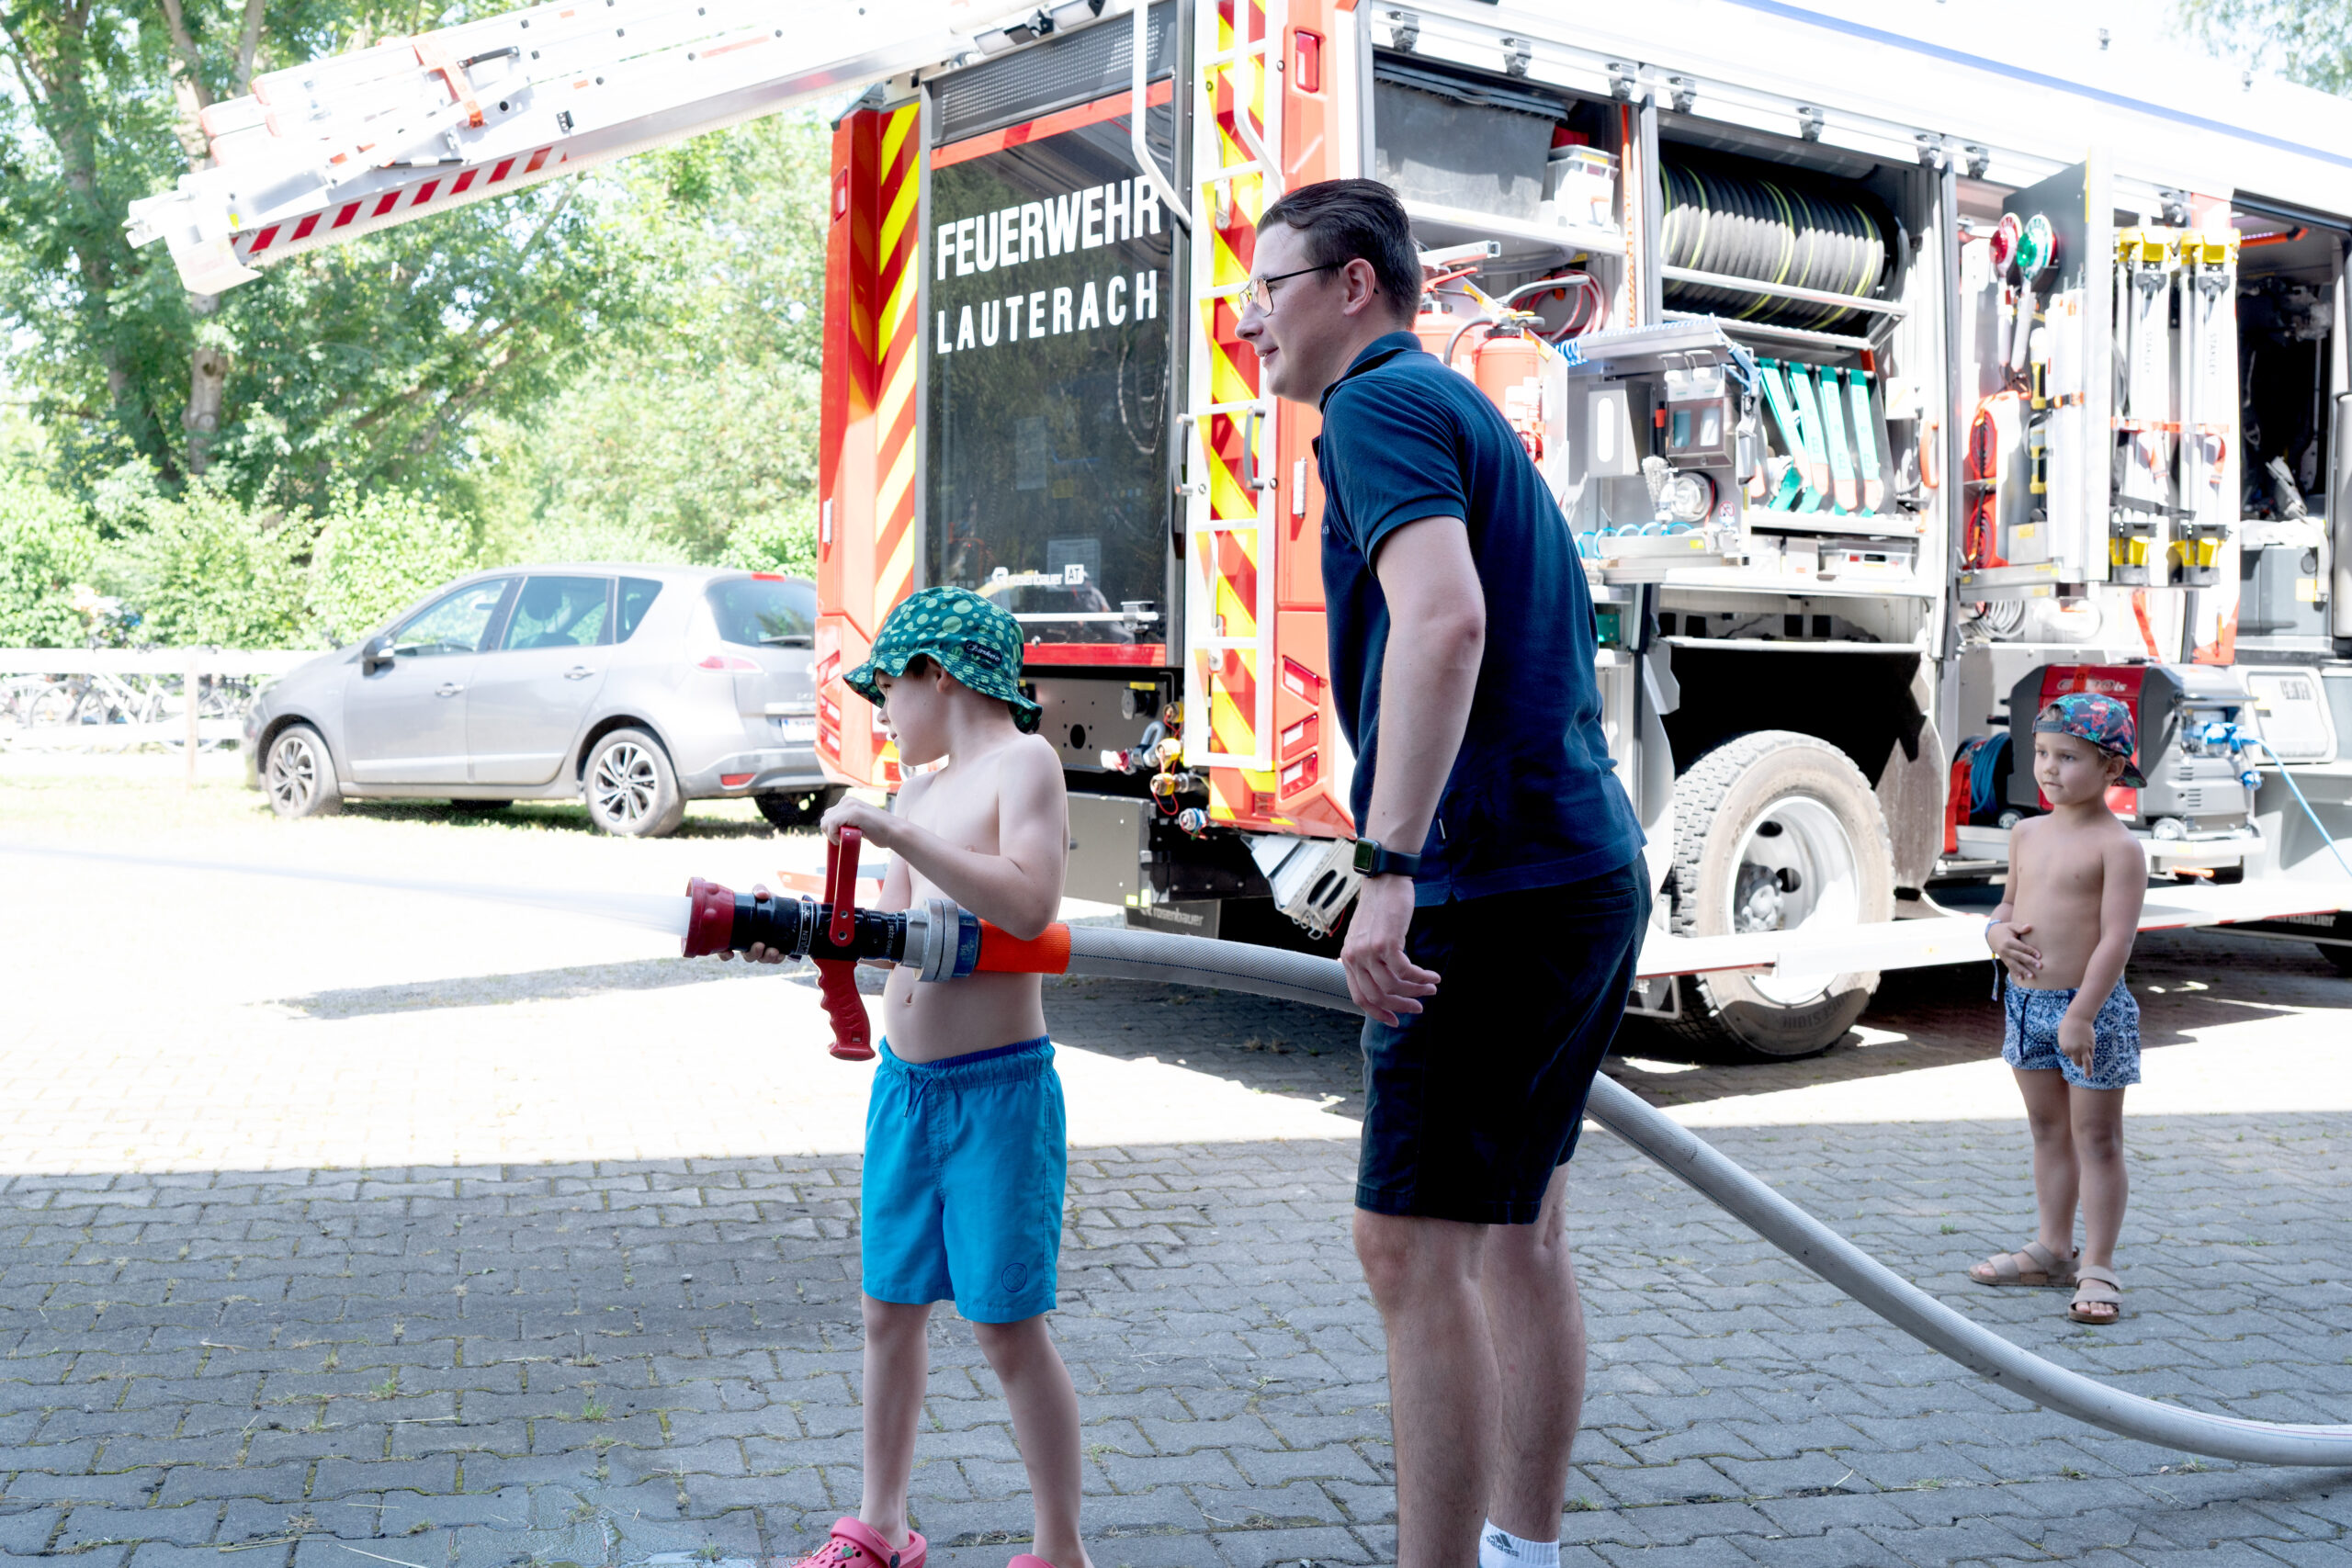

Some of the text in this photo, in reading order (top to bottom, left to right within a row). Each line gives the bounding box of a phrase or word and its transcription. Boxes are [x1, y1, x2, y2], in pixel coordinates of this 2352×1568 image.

[937, 175, 1161, 281] FEUERWEHR
[937, 269, 1158, 355] LAUTERACH
[1153, 907, 1204, 927] rosenbauer
[1486, 1536, 1520, 1557] adidas
